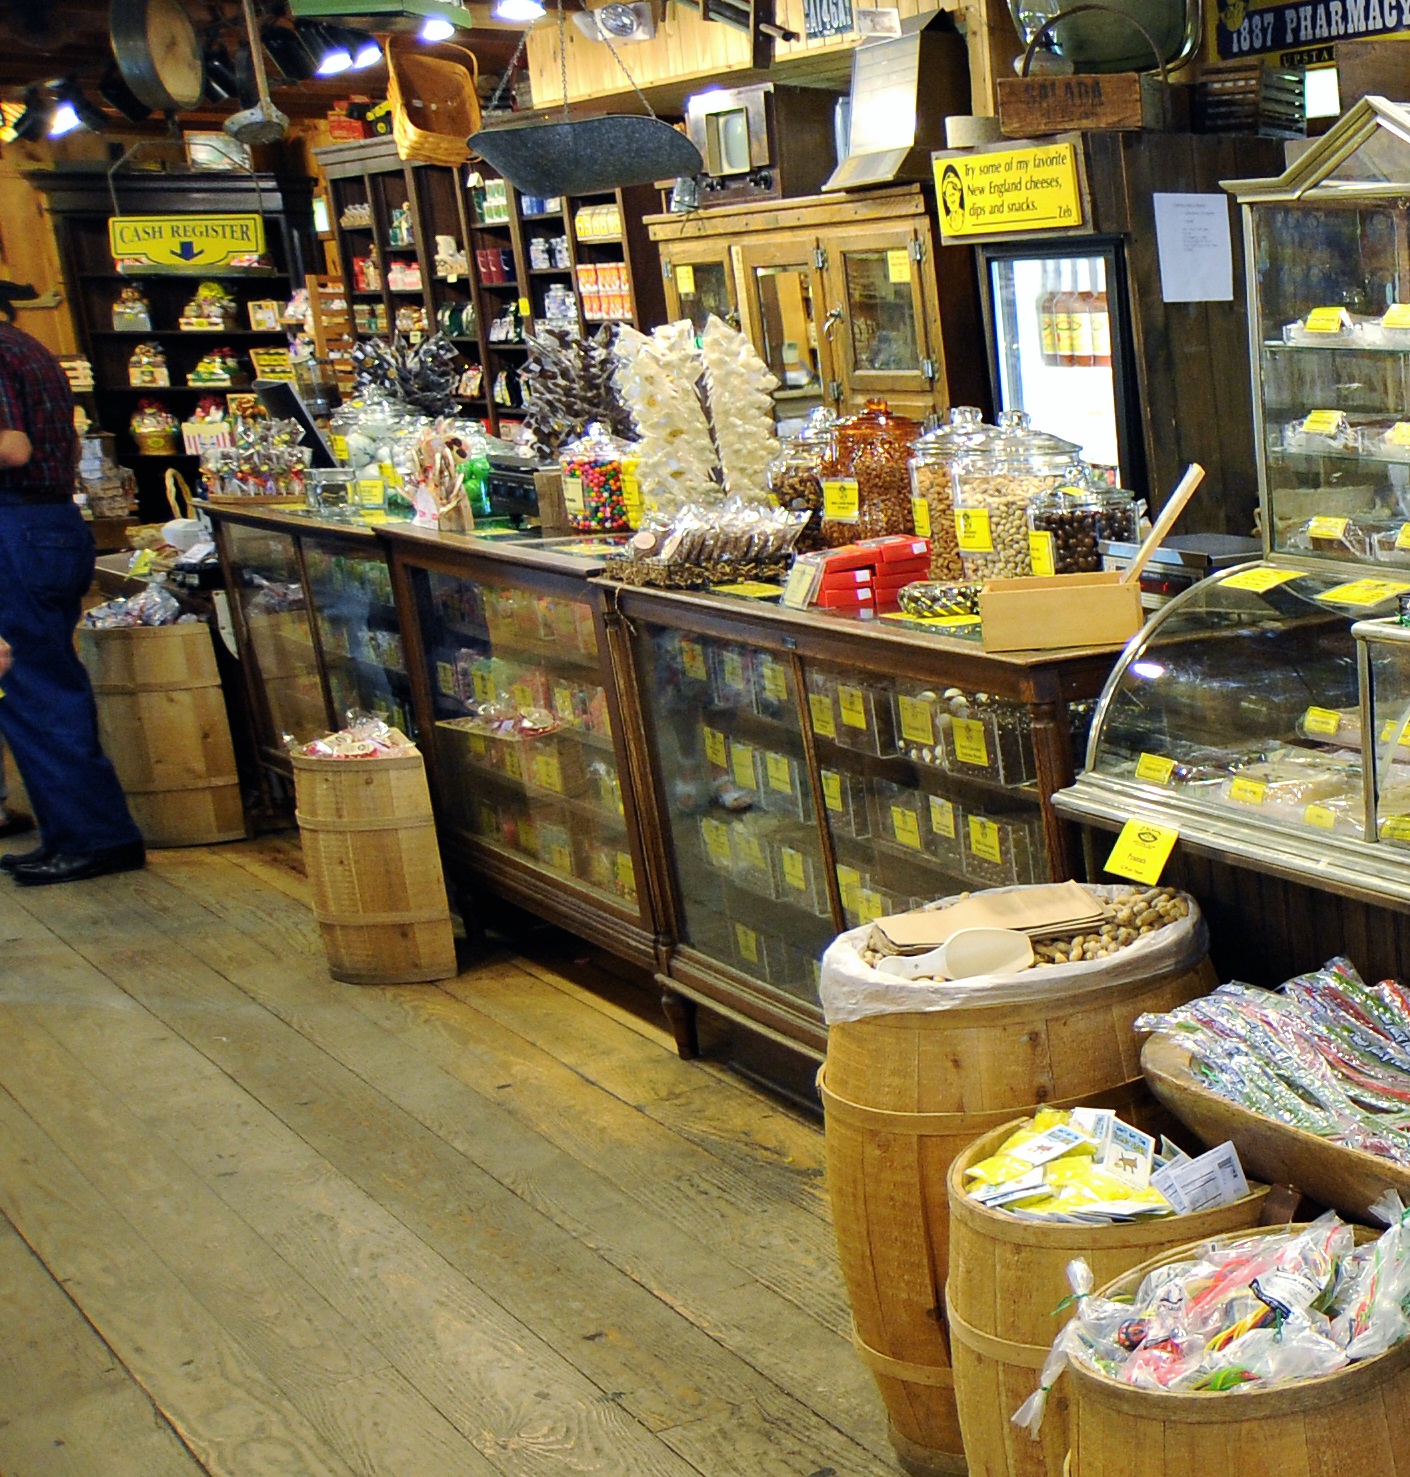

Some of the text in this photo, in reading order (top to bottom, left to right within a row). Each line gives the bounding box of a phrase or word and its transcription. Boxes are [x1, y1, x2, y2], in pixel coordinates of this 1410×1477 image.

[1233, 13, 1275, 53] 1887
[979, 163, 1002, 175] some
[1004, 157, 1015, 172] of
[1016, 159, 1031, 174] my
[1033, 152, 1067, 170] favorite
[967, 174, 1063, 198] New England cheeses,
[968, 204, 987, 220] dips
[988, 202, 1005, 216] and
[1057, 206, 1073, 219] Zeb
[120, 223, 252, 244] CASH REGISTER
